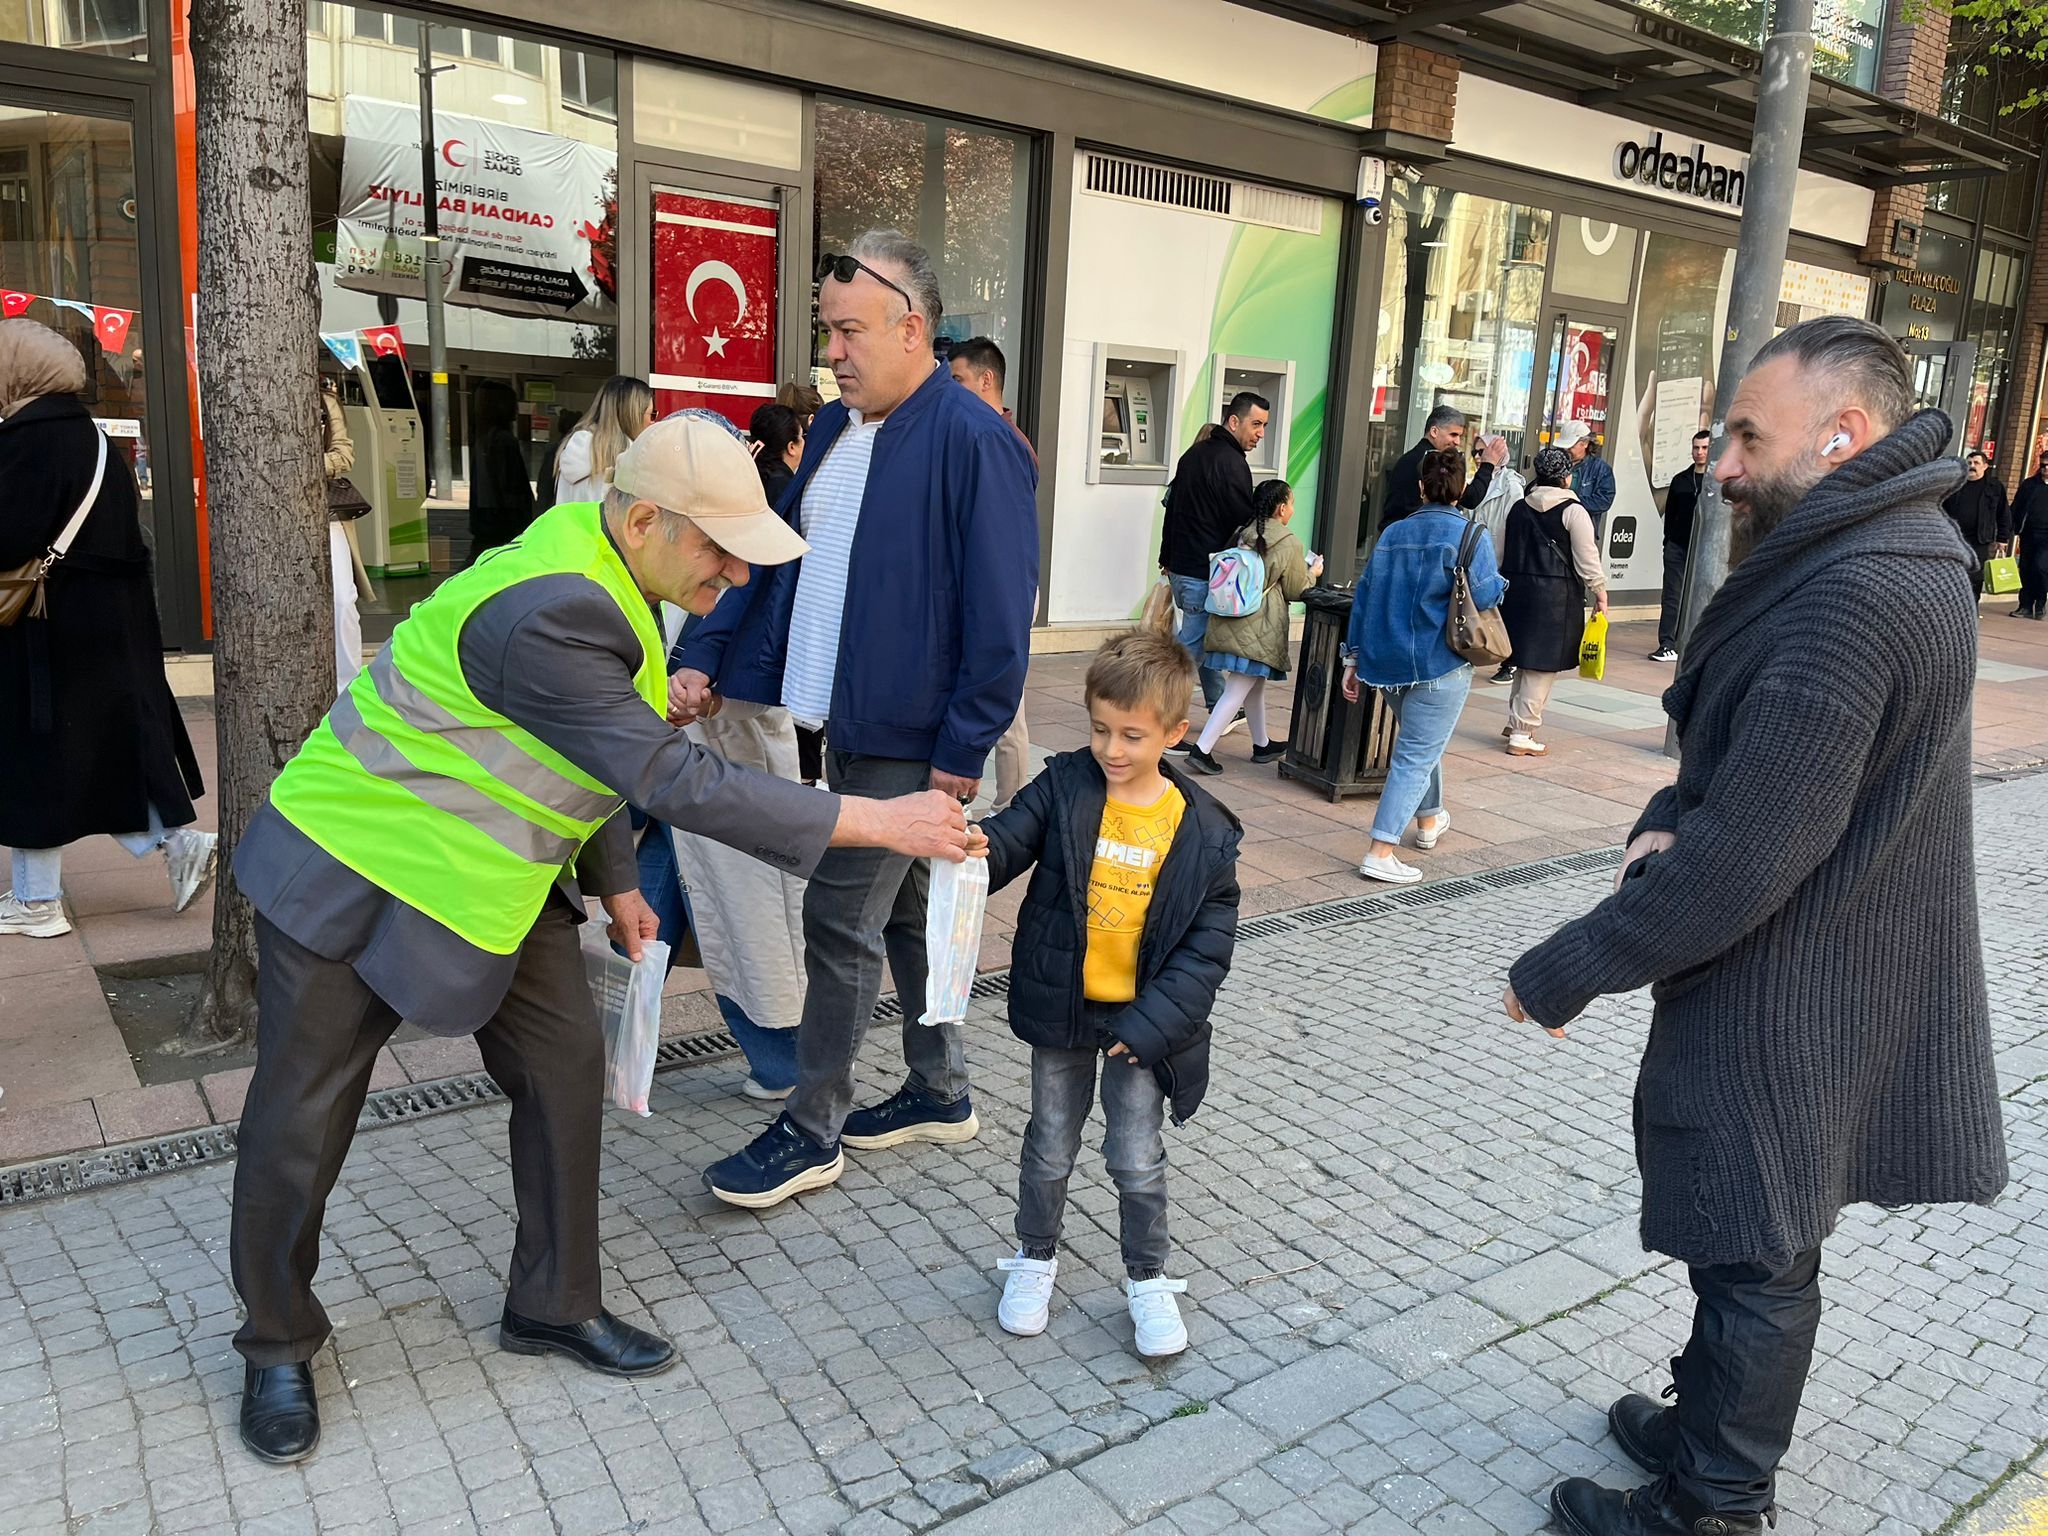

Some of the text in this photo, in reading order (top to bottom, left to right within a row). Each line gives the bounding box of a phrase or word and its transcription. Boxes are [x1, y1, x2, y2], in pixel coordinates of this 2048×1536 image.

[1614, 131, 1747, 207] odeaban
[1910, 293, 1937, 313] PLAZA
[1908, 322, 1930, 340] No:13
[1612, 528, 1634, 543] odea
[1094, 838, 1158, 868] AMER
[1108, 884, 1129, 895] SINCE
